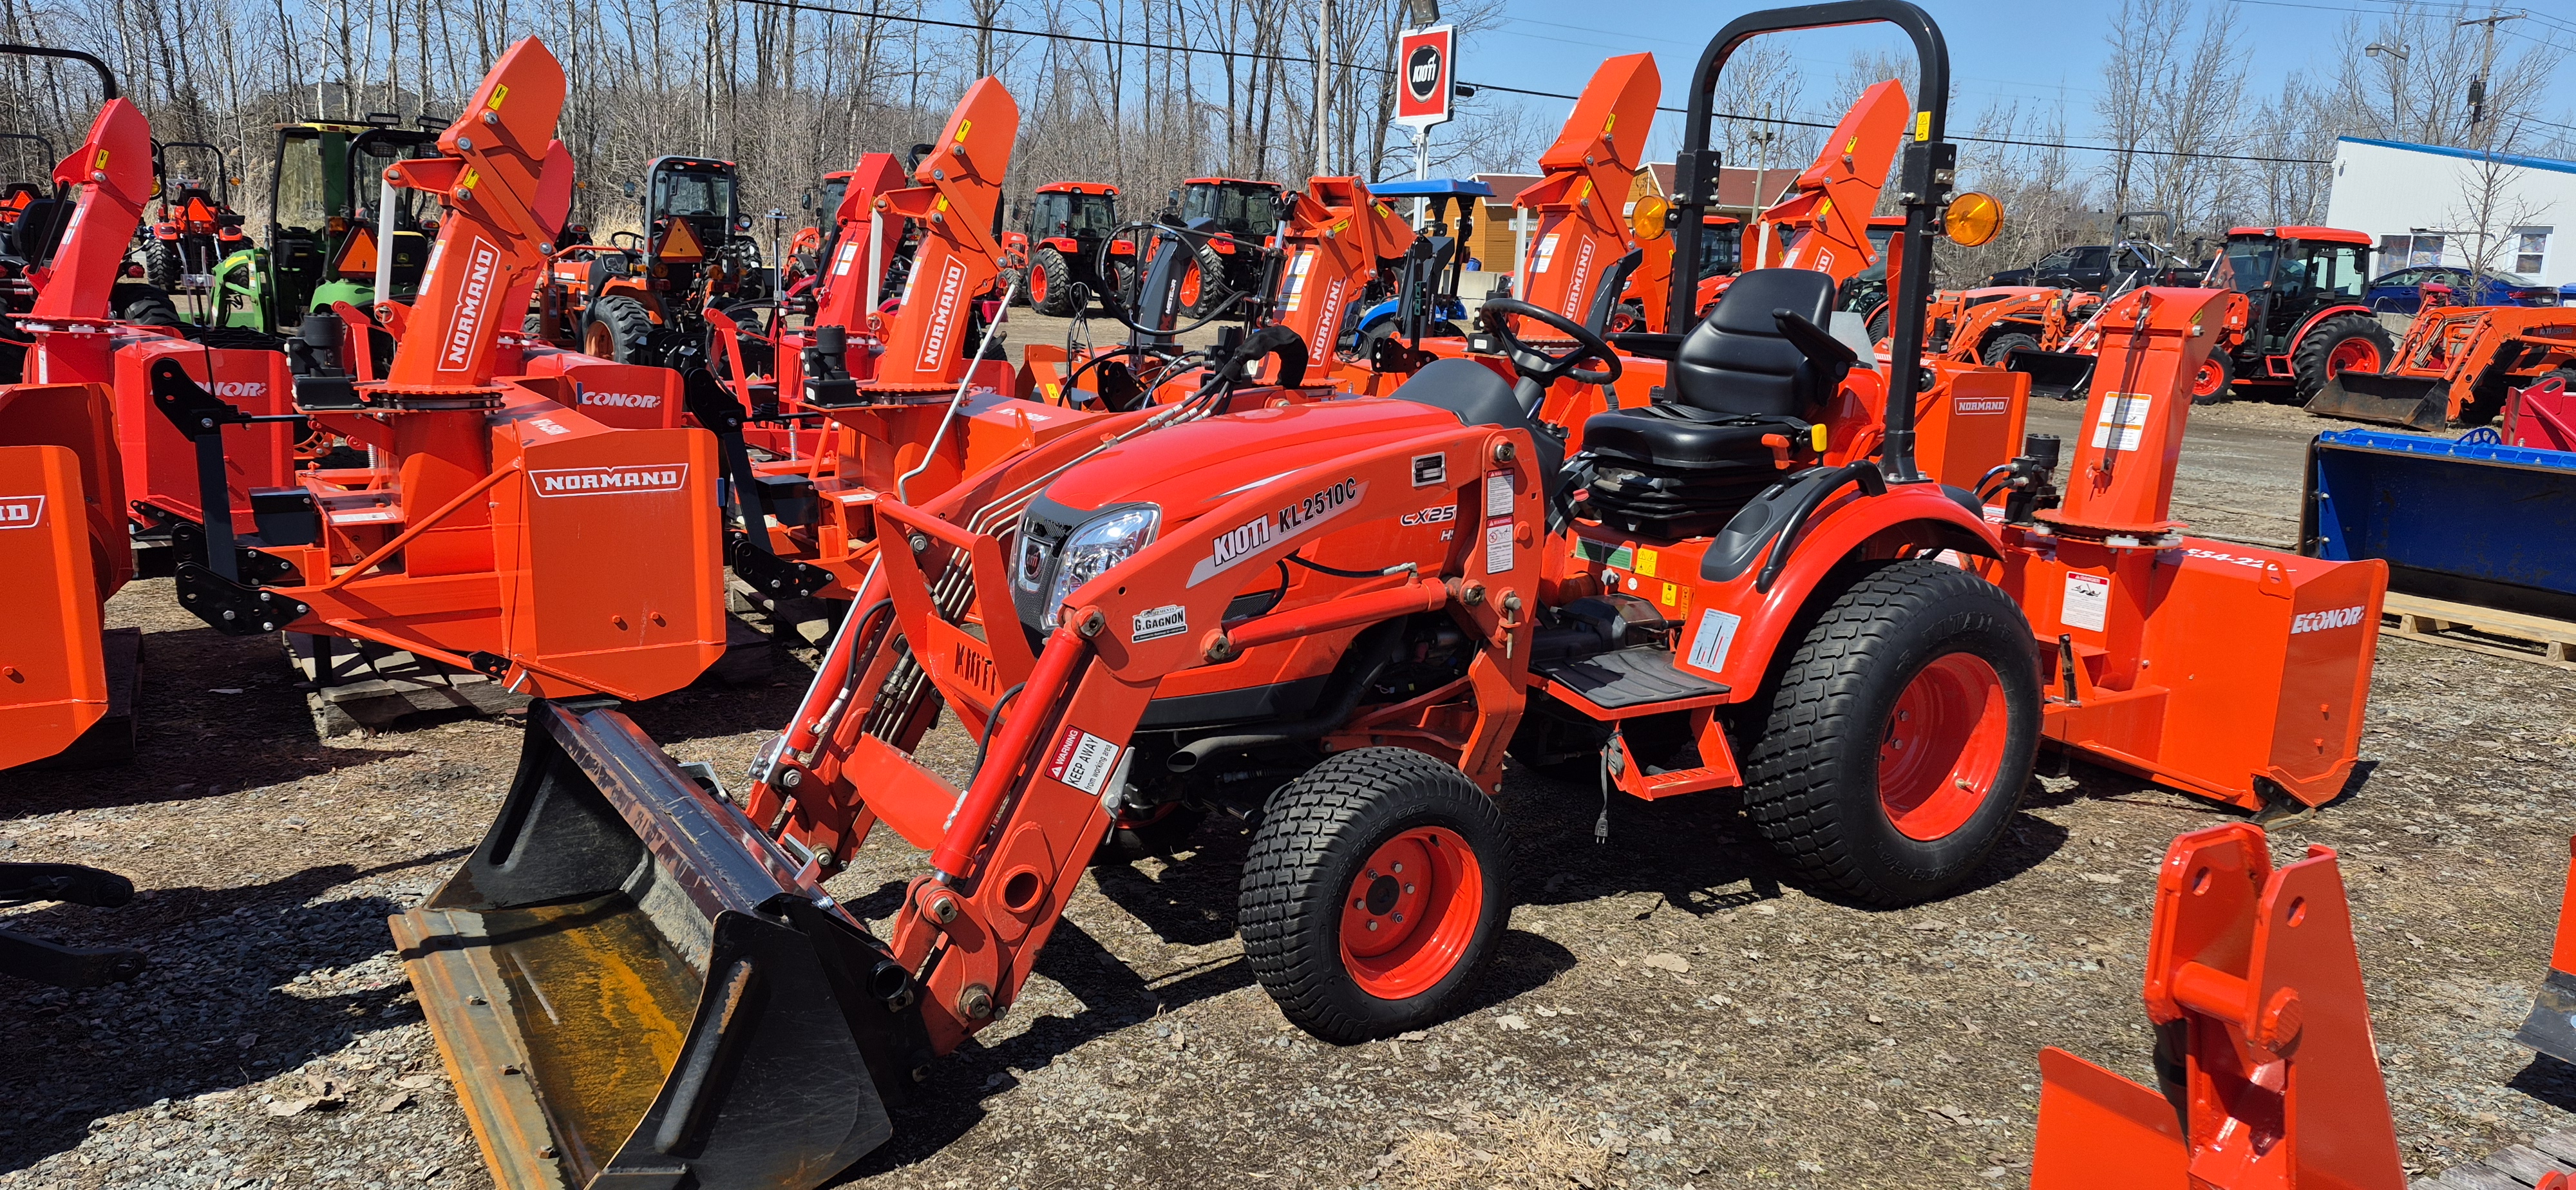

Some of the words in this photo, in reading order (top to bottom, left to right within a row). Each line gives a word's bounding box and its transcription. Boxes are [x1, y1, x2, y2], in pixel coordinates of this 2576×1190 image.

[1412, 63, 1437, 82] KIOTI
[1165, 279, 1177, 314] METEOR
[1564, 244, 1591, 320] NORMAND
[448, 249, 493, 363] NORMAND
[924, 266, 961, 365] NORMAND
[582, 392, 656, 408] CONOR
[1958, 401, 2005, 411] NORMAND
[544, 471, 677, 491] NORMAND
[1213, 513, 1270, 567] KIOTI
[1278, 477, 1357, 535] KL2510C
[1400, 505, 1457, 526] CX25
[1135, 610, 1184, 632] G.GAGNON
[2290, 606, 2362, 634] ECONOR
[954, 641, 996, 696] KIOTI
[1055, 729, 1079, 765] WARNING
[1067, 762, 1086, 786] KEEP
[1079, 737, 1099, 763] AWAY
[1084, 779, 1096, 791] from
[1092, 755, 1108, 780] working
[1102, 744, 1113, 757] area
